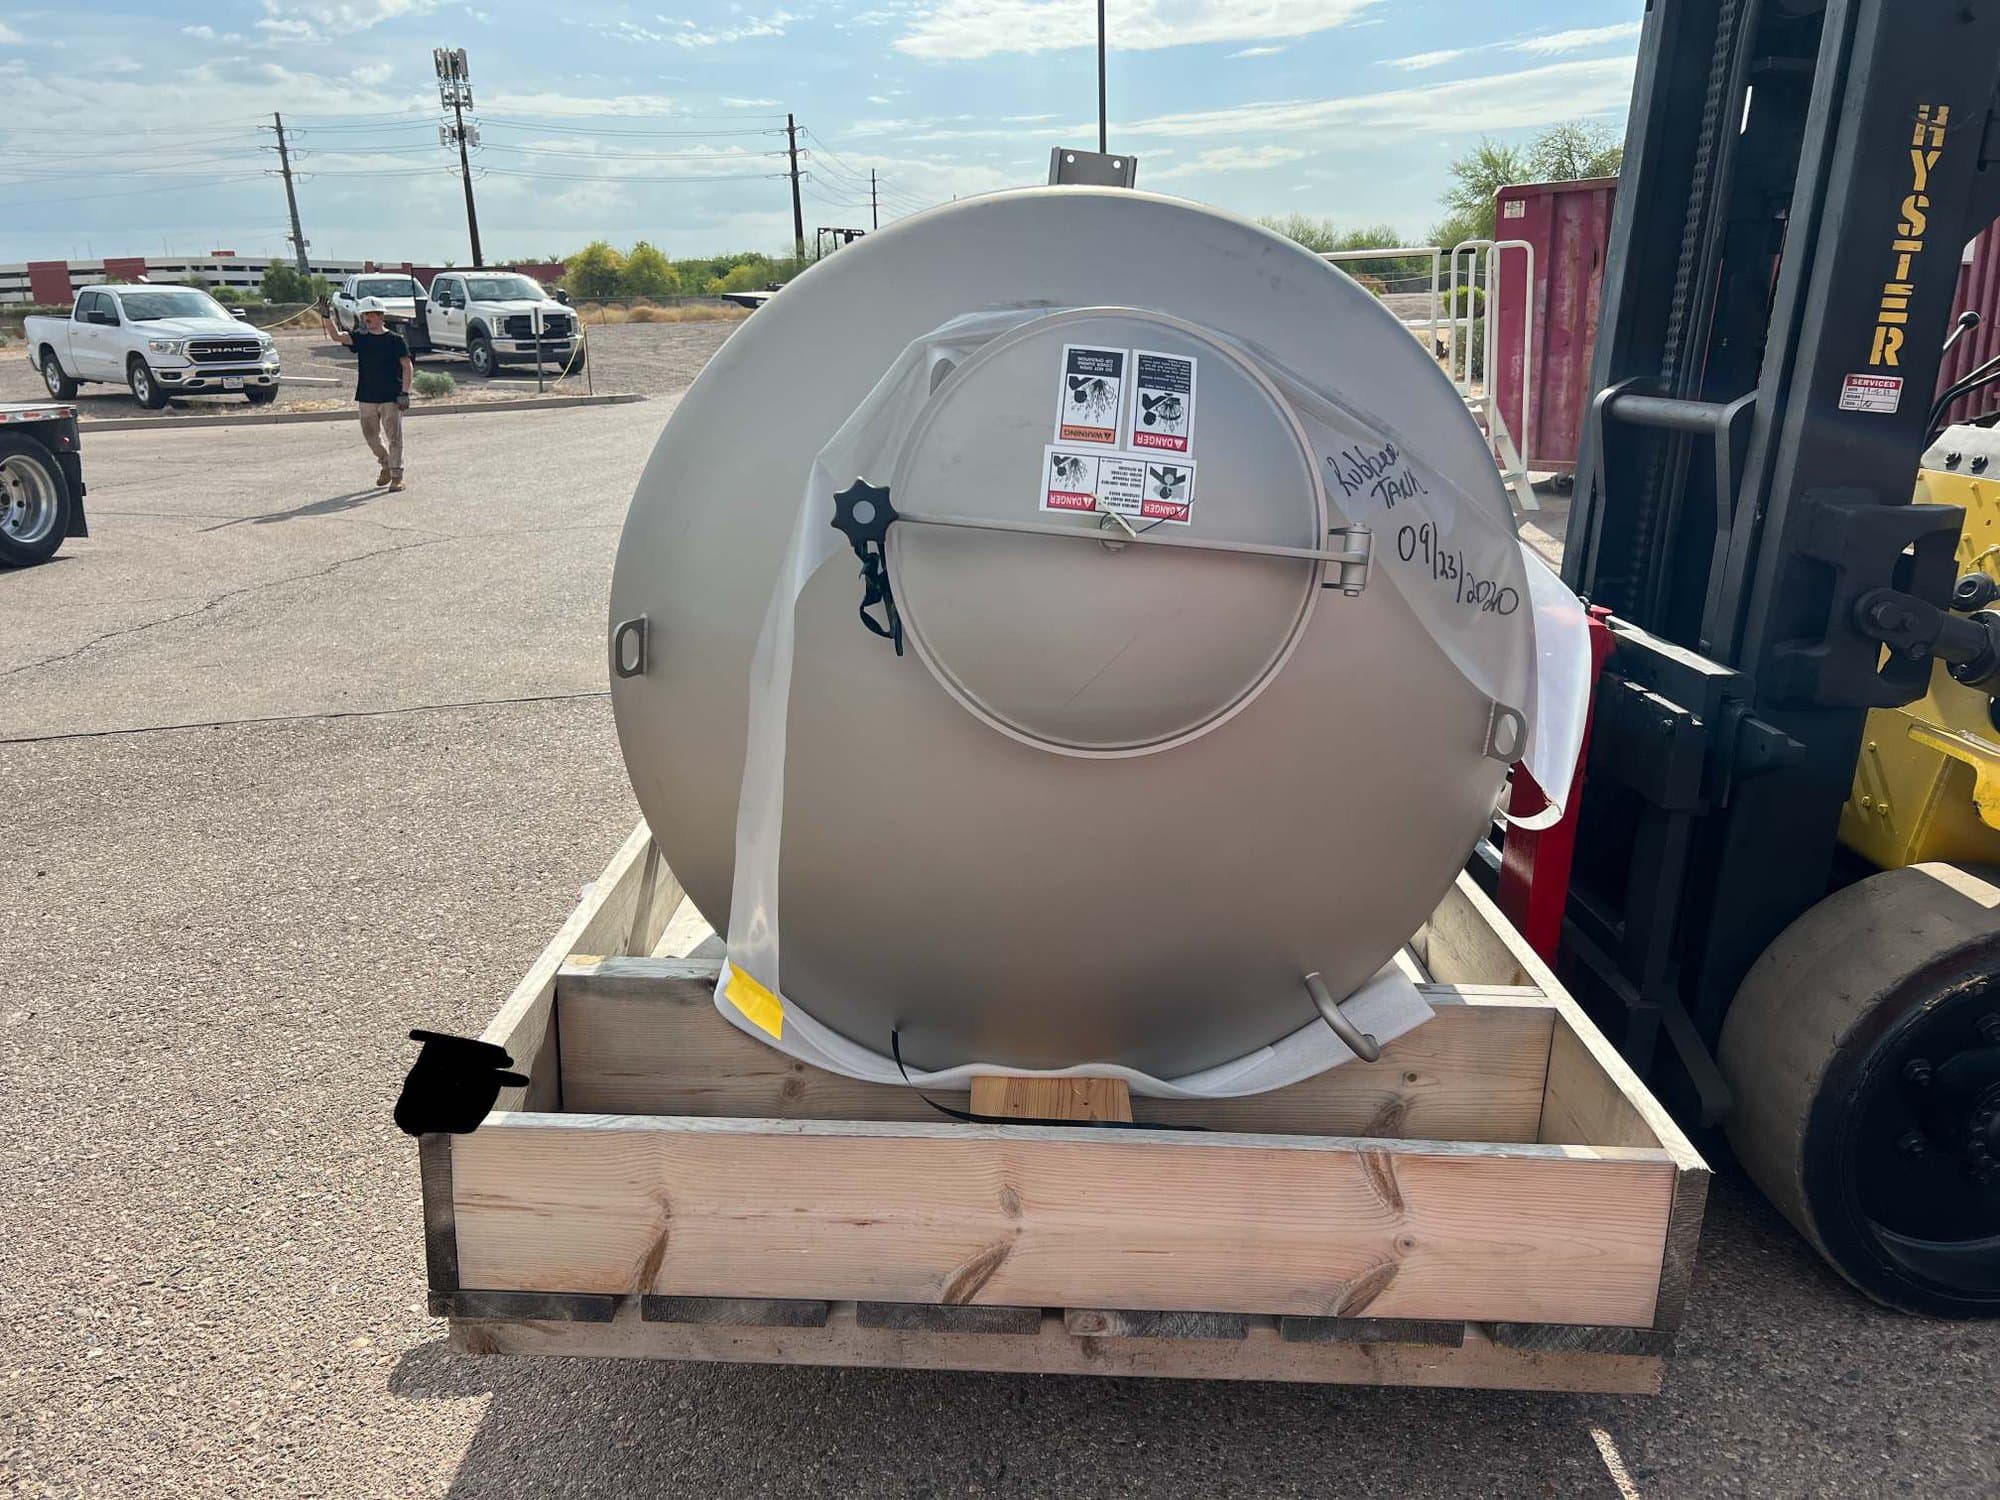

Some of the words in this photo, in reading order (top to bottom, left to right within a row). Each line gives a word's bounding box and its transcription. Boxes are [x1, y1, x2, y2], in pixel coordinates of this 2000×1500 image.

[1869, 104, 1949, 366] HYSTER
[1852, 378, 1896, 388] SERVICED
[1063, 429, 1103, 439] WARNING
[1137, 434, 1174, 448] DANGER
[1049, 494, 1082, 506] DANGER
[1144, 503, 1176, 515] DANGER
[1398, 521, 1519, 615] 09/23/2020
